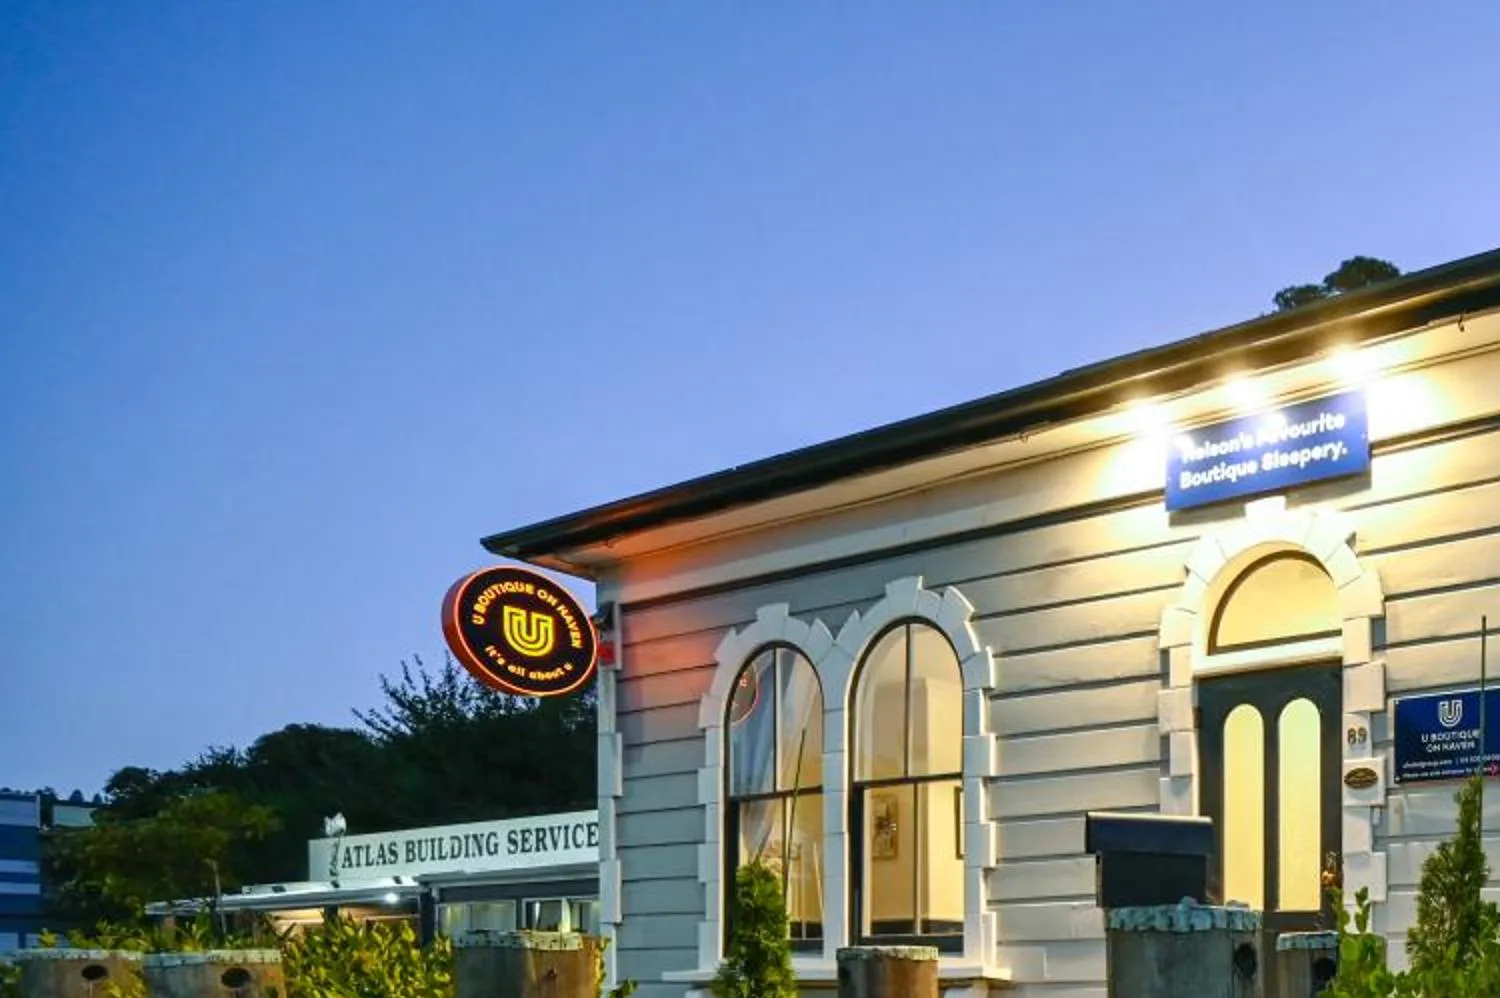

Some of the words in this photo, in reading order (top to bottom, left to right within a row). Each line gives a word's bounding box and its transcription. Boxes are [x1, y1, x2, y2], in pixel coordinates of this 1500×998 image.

[1179, 459, 1258, 490] Boutique
[1261, 440, 1348, 471] Sleepery.
[473, 581, 535, 612] BOUTIQUE
[537, 589, 558, 606] ON
[556, 605, 583, 649] HAVEN
[1348, 727, 1367, 744] 89
[1430, 729, 1480, 742] BOUTIQUE
[341, 841, 398, 868] ATLAS
[405, 832, 499, 863] BUILDING
